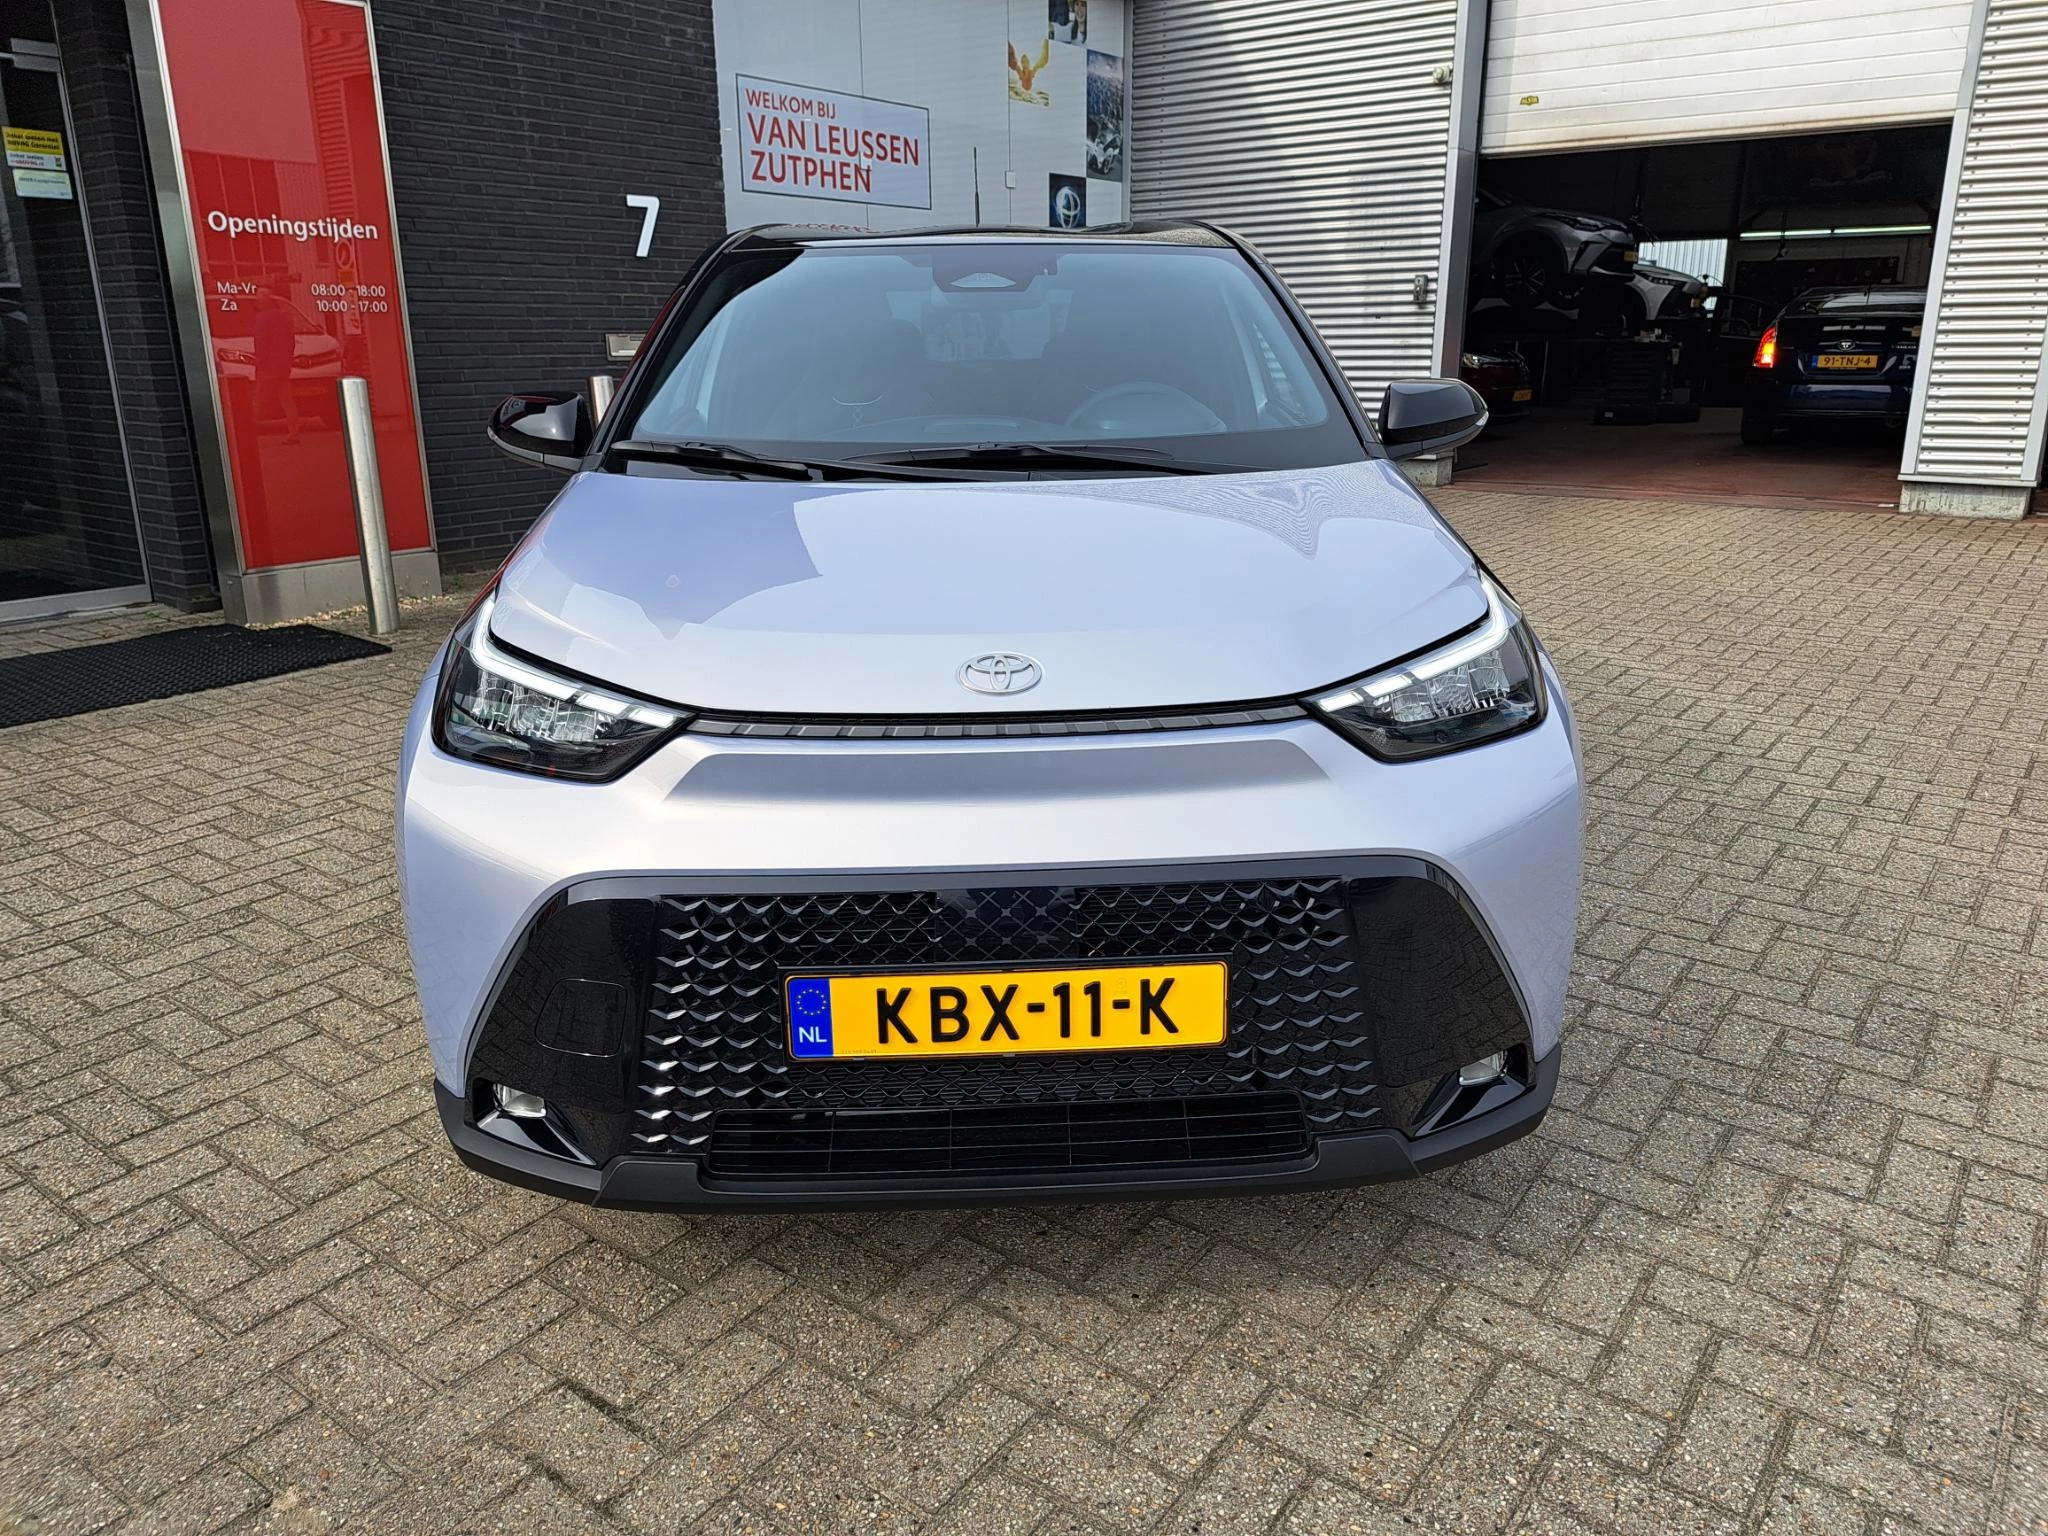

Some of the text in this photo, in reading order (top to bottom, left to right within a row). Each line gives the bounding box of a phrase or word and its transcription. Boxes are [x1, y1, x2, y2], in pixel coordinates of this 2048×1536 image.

[745, 88, 836, 119] WELKOM BIJ
[747, 112, 919, 166] VAN LEUSSEN
[750, 150, 871, 193] ZUTPHEN
[207, 210, 379, 243] Openingstijden
[626, 194, 660, 257] 7
[217, 282, 257, 294] Ma-Vr
[311, 284, 346, 296] 08:00
[356, 285, 386, 297] 18:00
[221, 299, 238, 311] Za
[316, 301, 348, 312] 10:00
[358, 301, 388, 313] 17:00
[1823, 356, 1871, 366] 91-TNJ-4
[876, 977, 1180, 1044] KBX-11-K
[798, 1026, 827, 1043] NL
